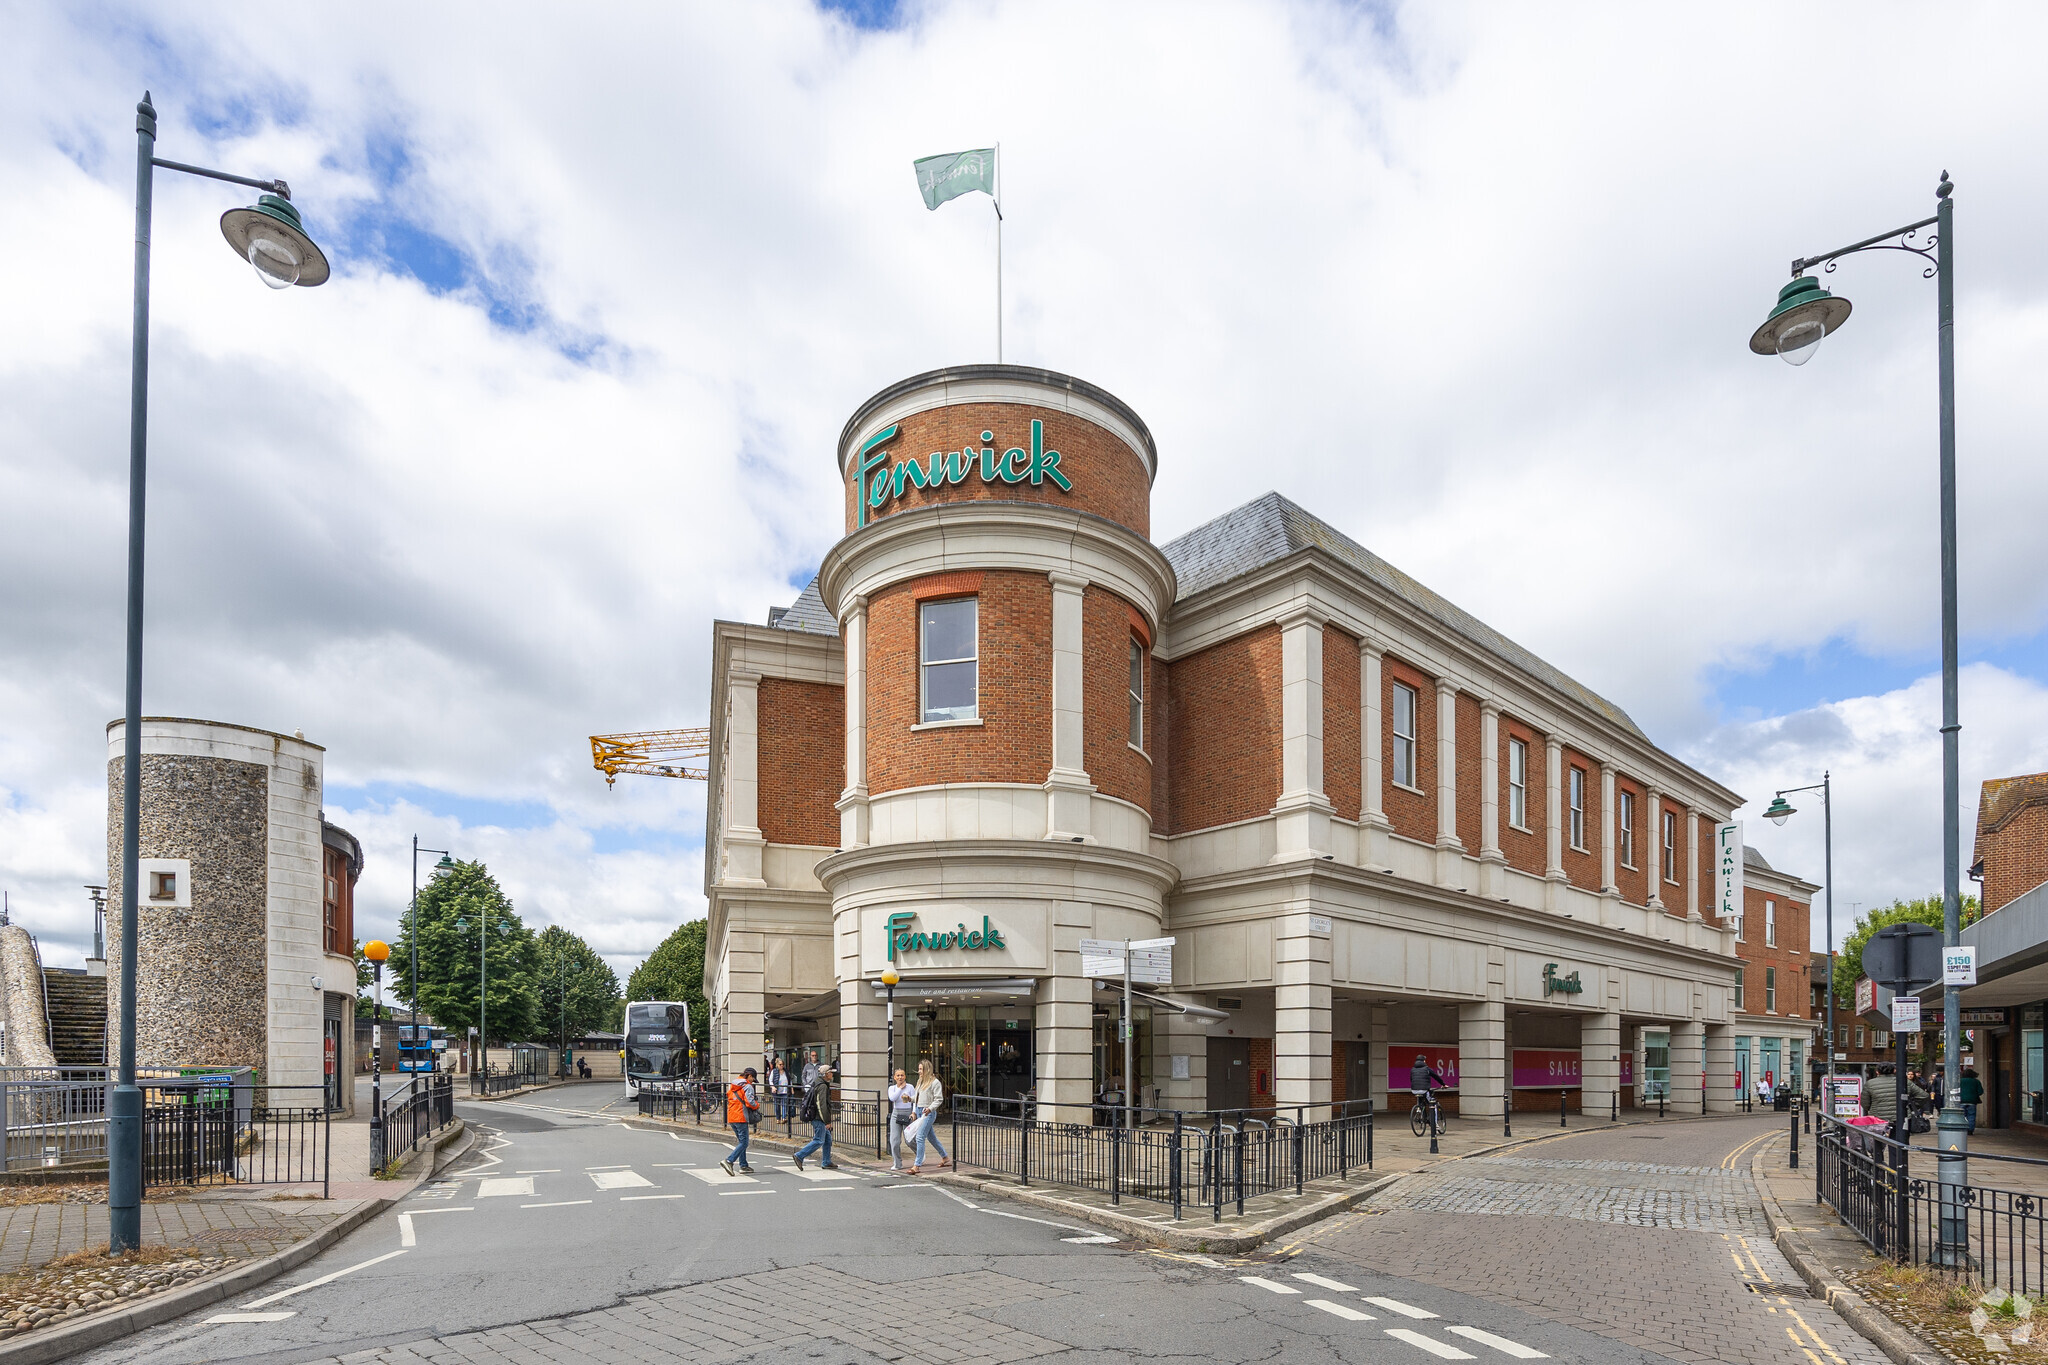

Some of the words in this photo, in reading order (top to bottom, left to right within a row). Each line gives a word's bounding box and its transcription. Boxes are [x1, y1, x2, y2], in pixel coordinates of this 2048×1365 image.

[852, 418, 1073, 529] Fenwick
[1719, 825, 1738, 913] Fenwick
[883, 911, 1006, 962] Fenwick
[1947, 956, 1971, 965] £150
[1542, 963, 1584, 997] Fenwick
[1436, 1059, 1455, 1077] SA
[1549, 1060, 1577, 1076] SALE
